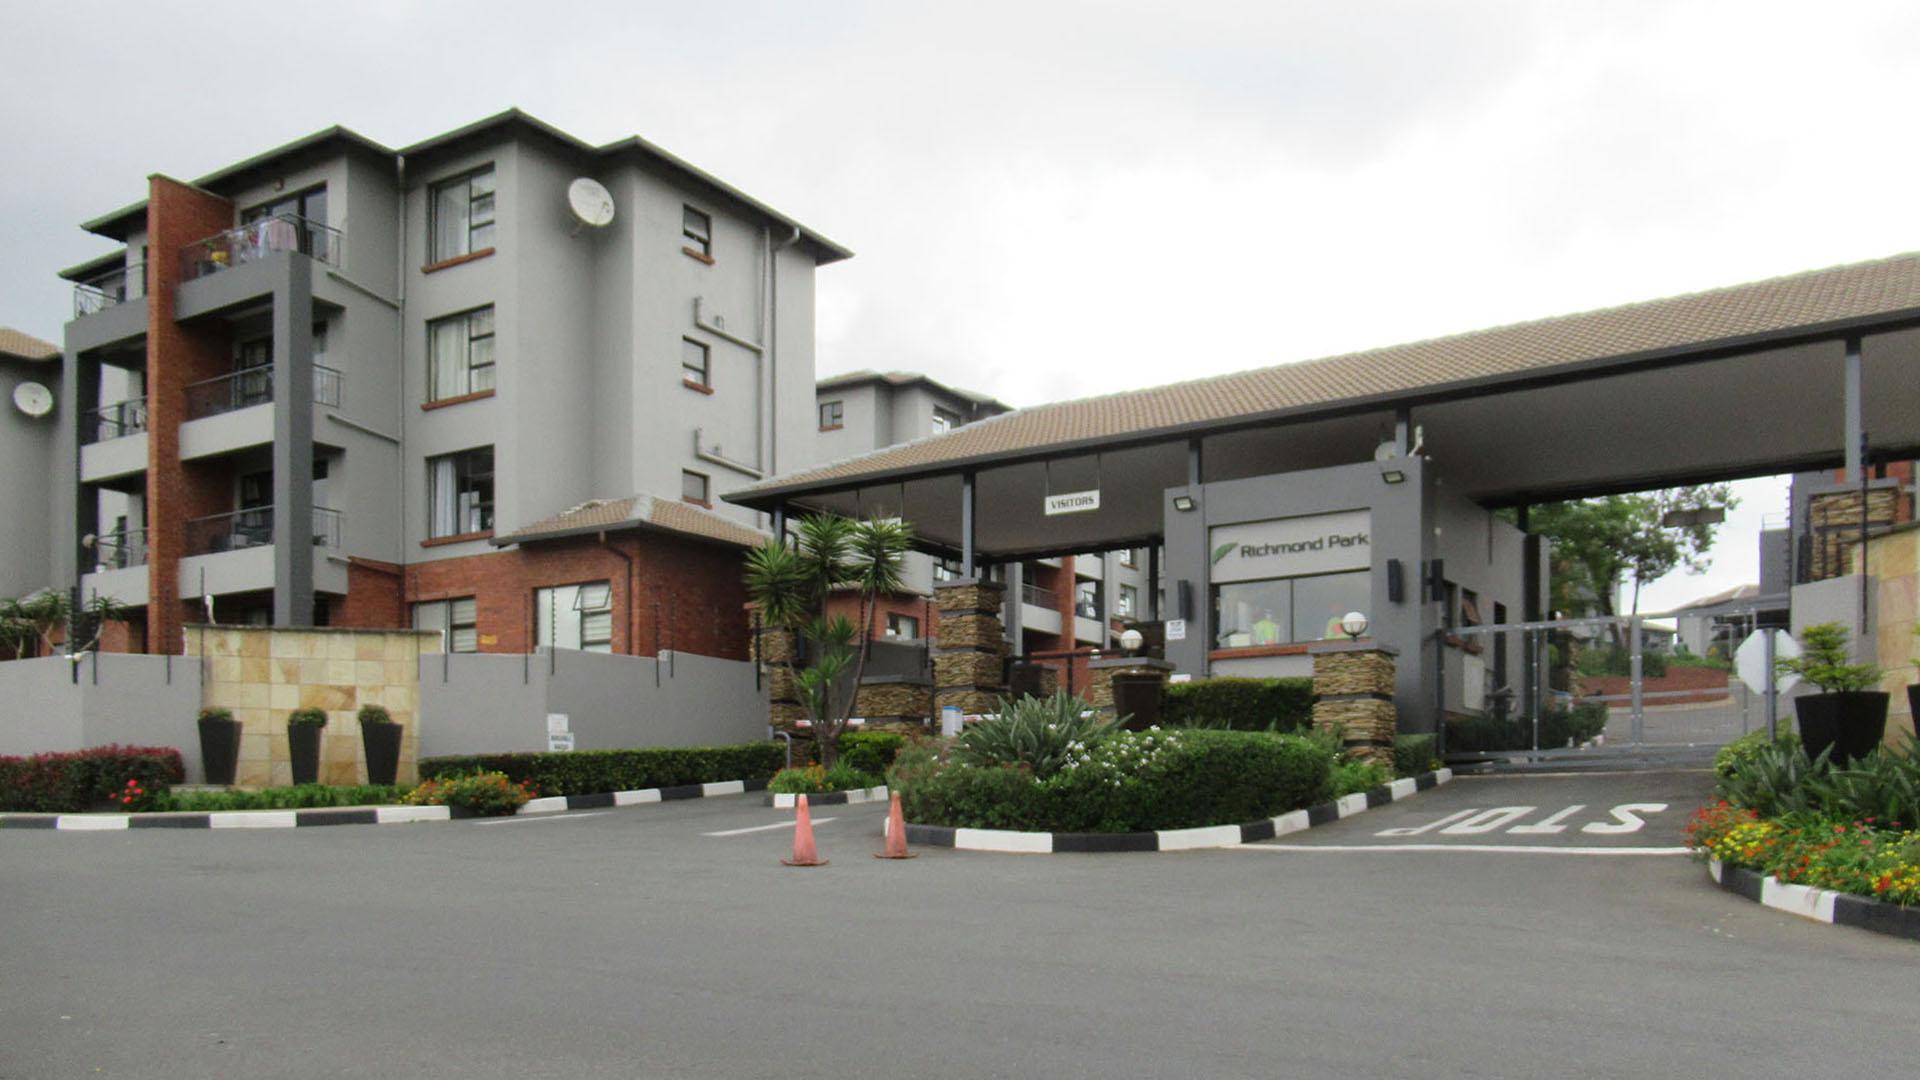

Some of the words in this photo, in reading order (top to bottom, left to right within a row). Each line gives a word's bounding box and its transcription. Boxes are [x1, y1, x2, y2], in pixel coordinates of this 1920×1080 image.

[1051, 496, 1095, 509] VISITORS
[1241, 537, 1323, 558] Richmond
[1328, 532, 1369, 548] Park
[1373, 803, 1669, 836] STOP
